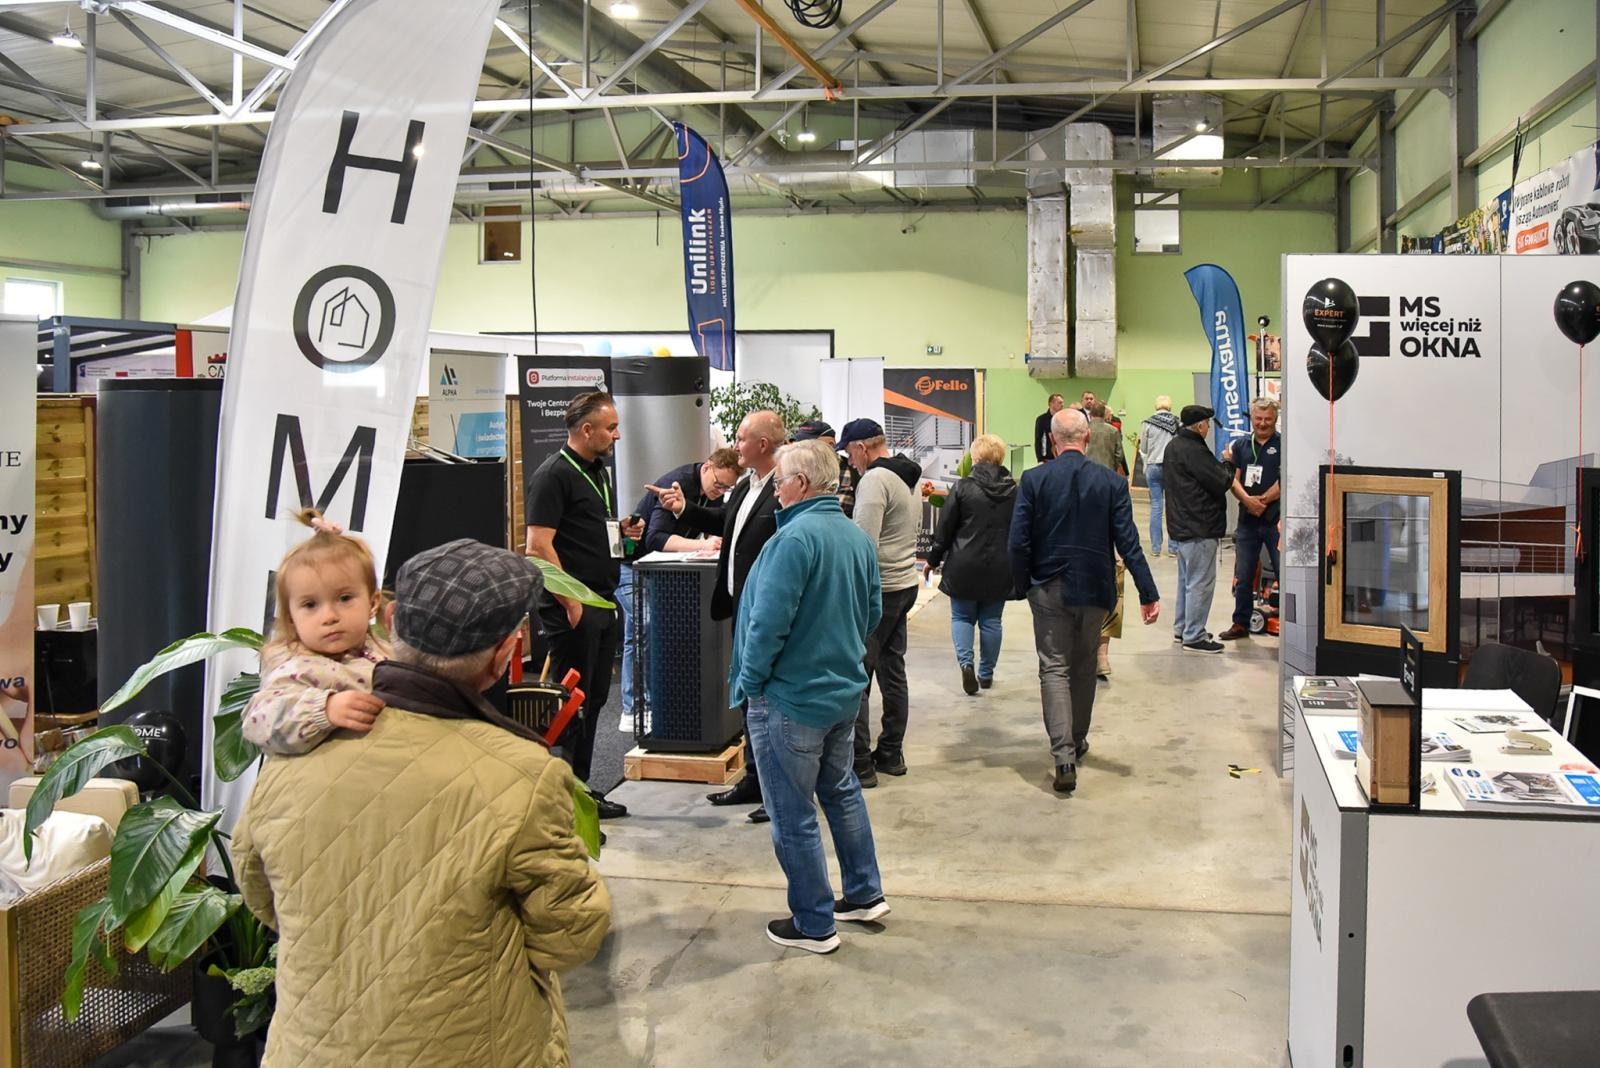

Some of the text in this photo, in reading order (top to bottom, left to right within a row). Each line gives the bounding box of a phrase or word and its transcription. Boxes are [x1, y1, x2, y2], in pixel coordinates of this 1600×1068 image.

[688, 208, 707, 294] Unilink
[1400, 296, 1441, 317] MS
[1314, 309, 1344, 318] EXPERT
[1400, 318, 1482, 336] więcej niż
[1400, 337, 1481, 358] OKNA
[208, 365, 225, 378] CA
[934, 379, 968, 391] Fello
[442, 388, 457, 396] ALPHA
[547, 400, 572, 408] Centru
[545, 410, 567, 418] Bezpie
[0, 451, 21, 467] E
[135, 728, 161, 738] OME
